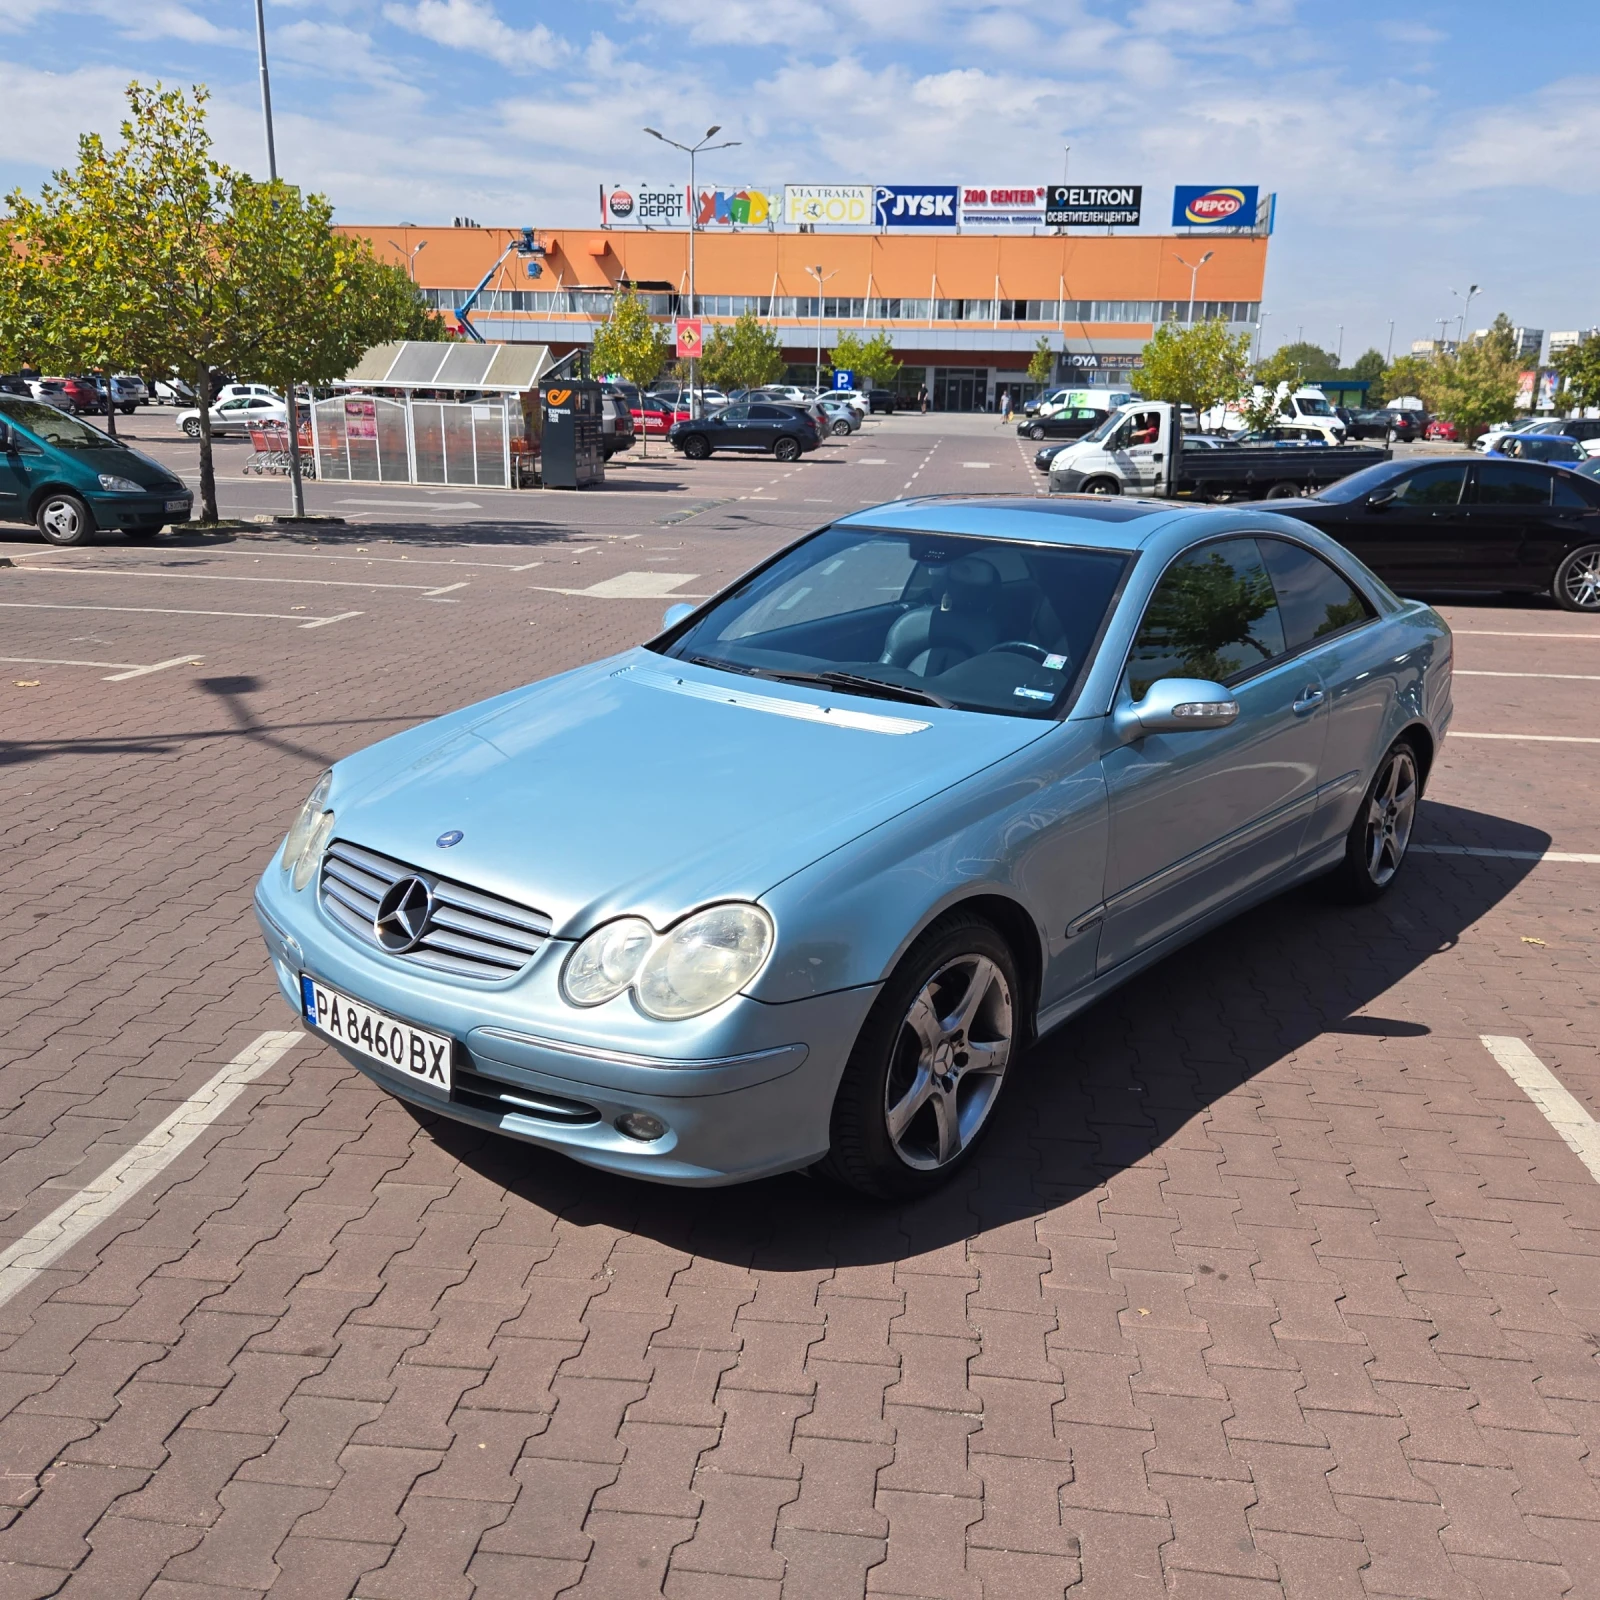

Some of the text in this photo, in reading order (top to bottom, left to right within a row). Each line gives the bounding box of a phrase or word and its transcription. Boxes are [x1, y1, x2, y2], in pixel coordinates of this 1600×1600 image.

[639, 193, 684, 205] SPORT
[791, 188, 865, 198] VIA TRAKIA
[964, 190, 1035, 204] ZOO CENTER
[639, 205, 684, 217] DEPOT
[791, 198, 865, 221] FOOD
[891, 194, 954, 216] JYSK
[1194, 200, 1236, 212] PEPCO
[1062, 355, 1098, 367] HOYA
[837, 373, 849, 388] P
[306, 1004, 316, 1018] BG
